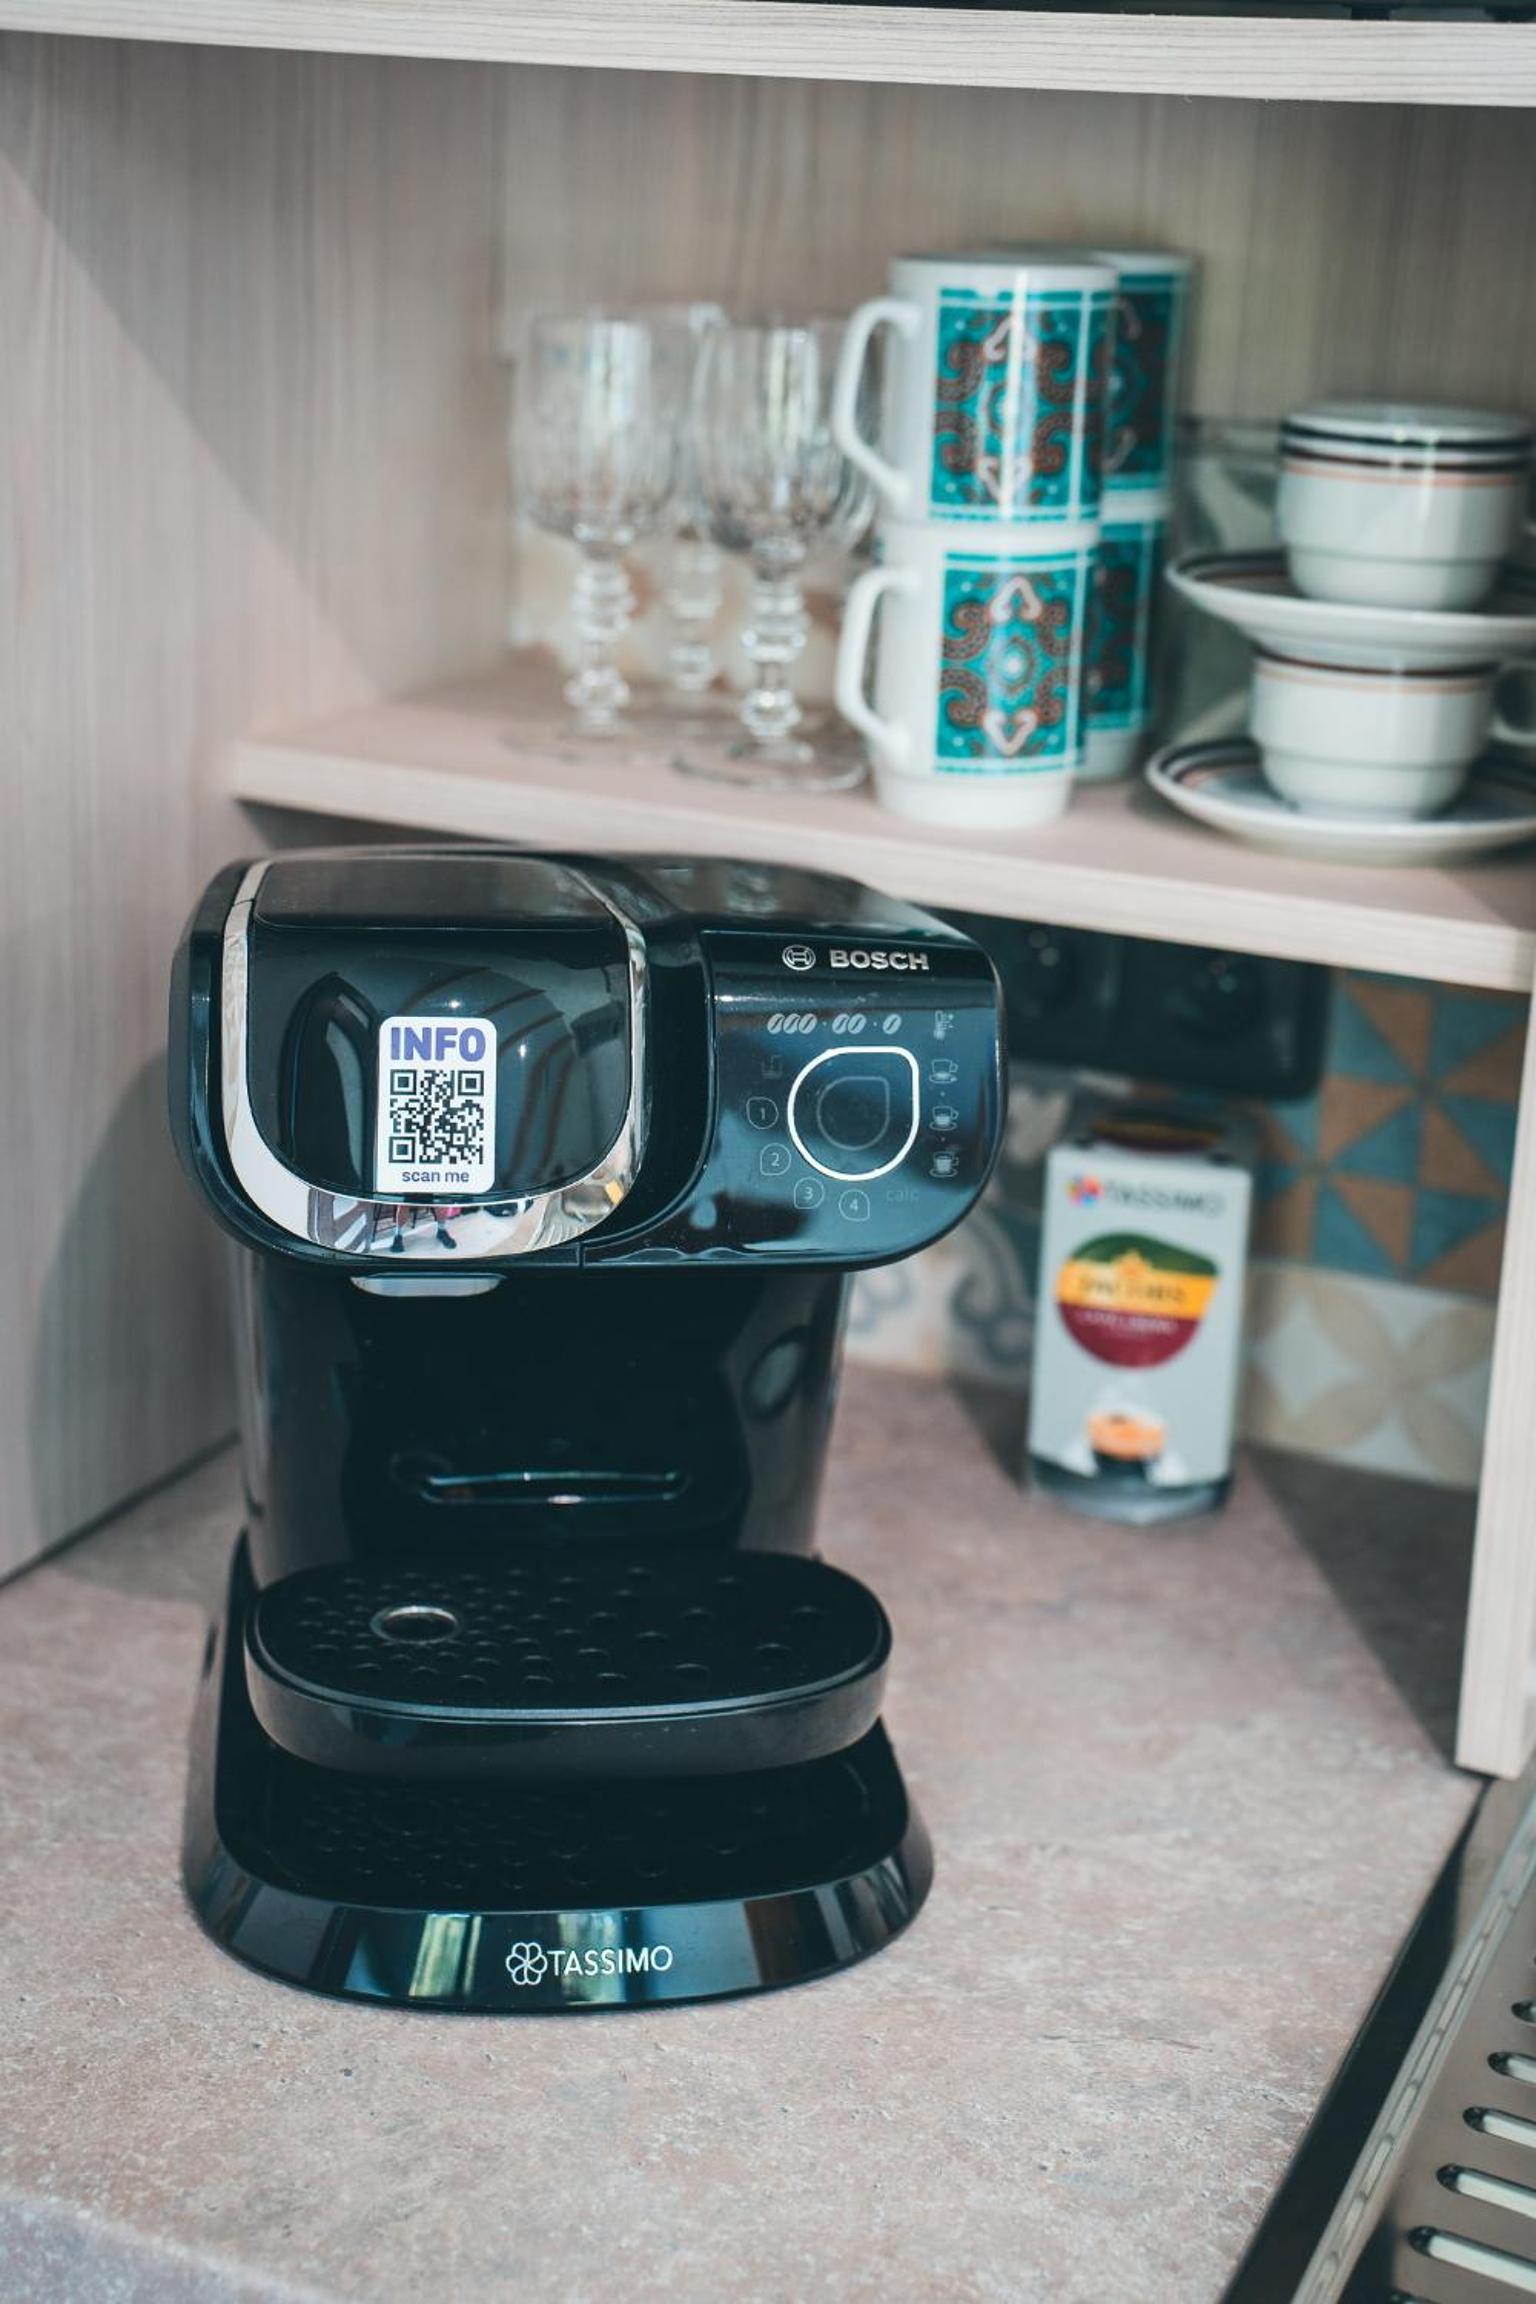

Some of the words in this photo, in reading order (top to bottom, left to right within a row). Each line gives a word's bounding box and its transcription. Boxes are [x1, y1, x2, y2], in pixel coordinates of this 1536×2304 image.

[829, 949, 930, 971] BOSCH
[390, 1026, 487, 1063] INFO
[759, 1107, 767, 1121] 1
[769, 1152, 781, 1167] 2
[402, 1170, 441, 1183] scan
[445, 1171, 470, 1183] me
[804, 1186, 814, 1201] 3
[849, 1199, 859, 1212] 4
[546, 1945, 674, 1977] TASSIMO
